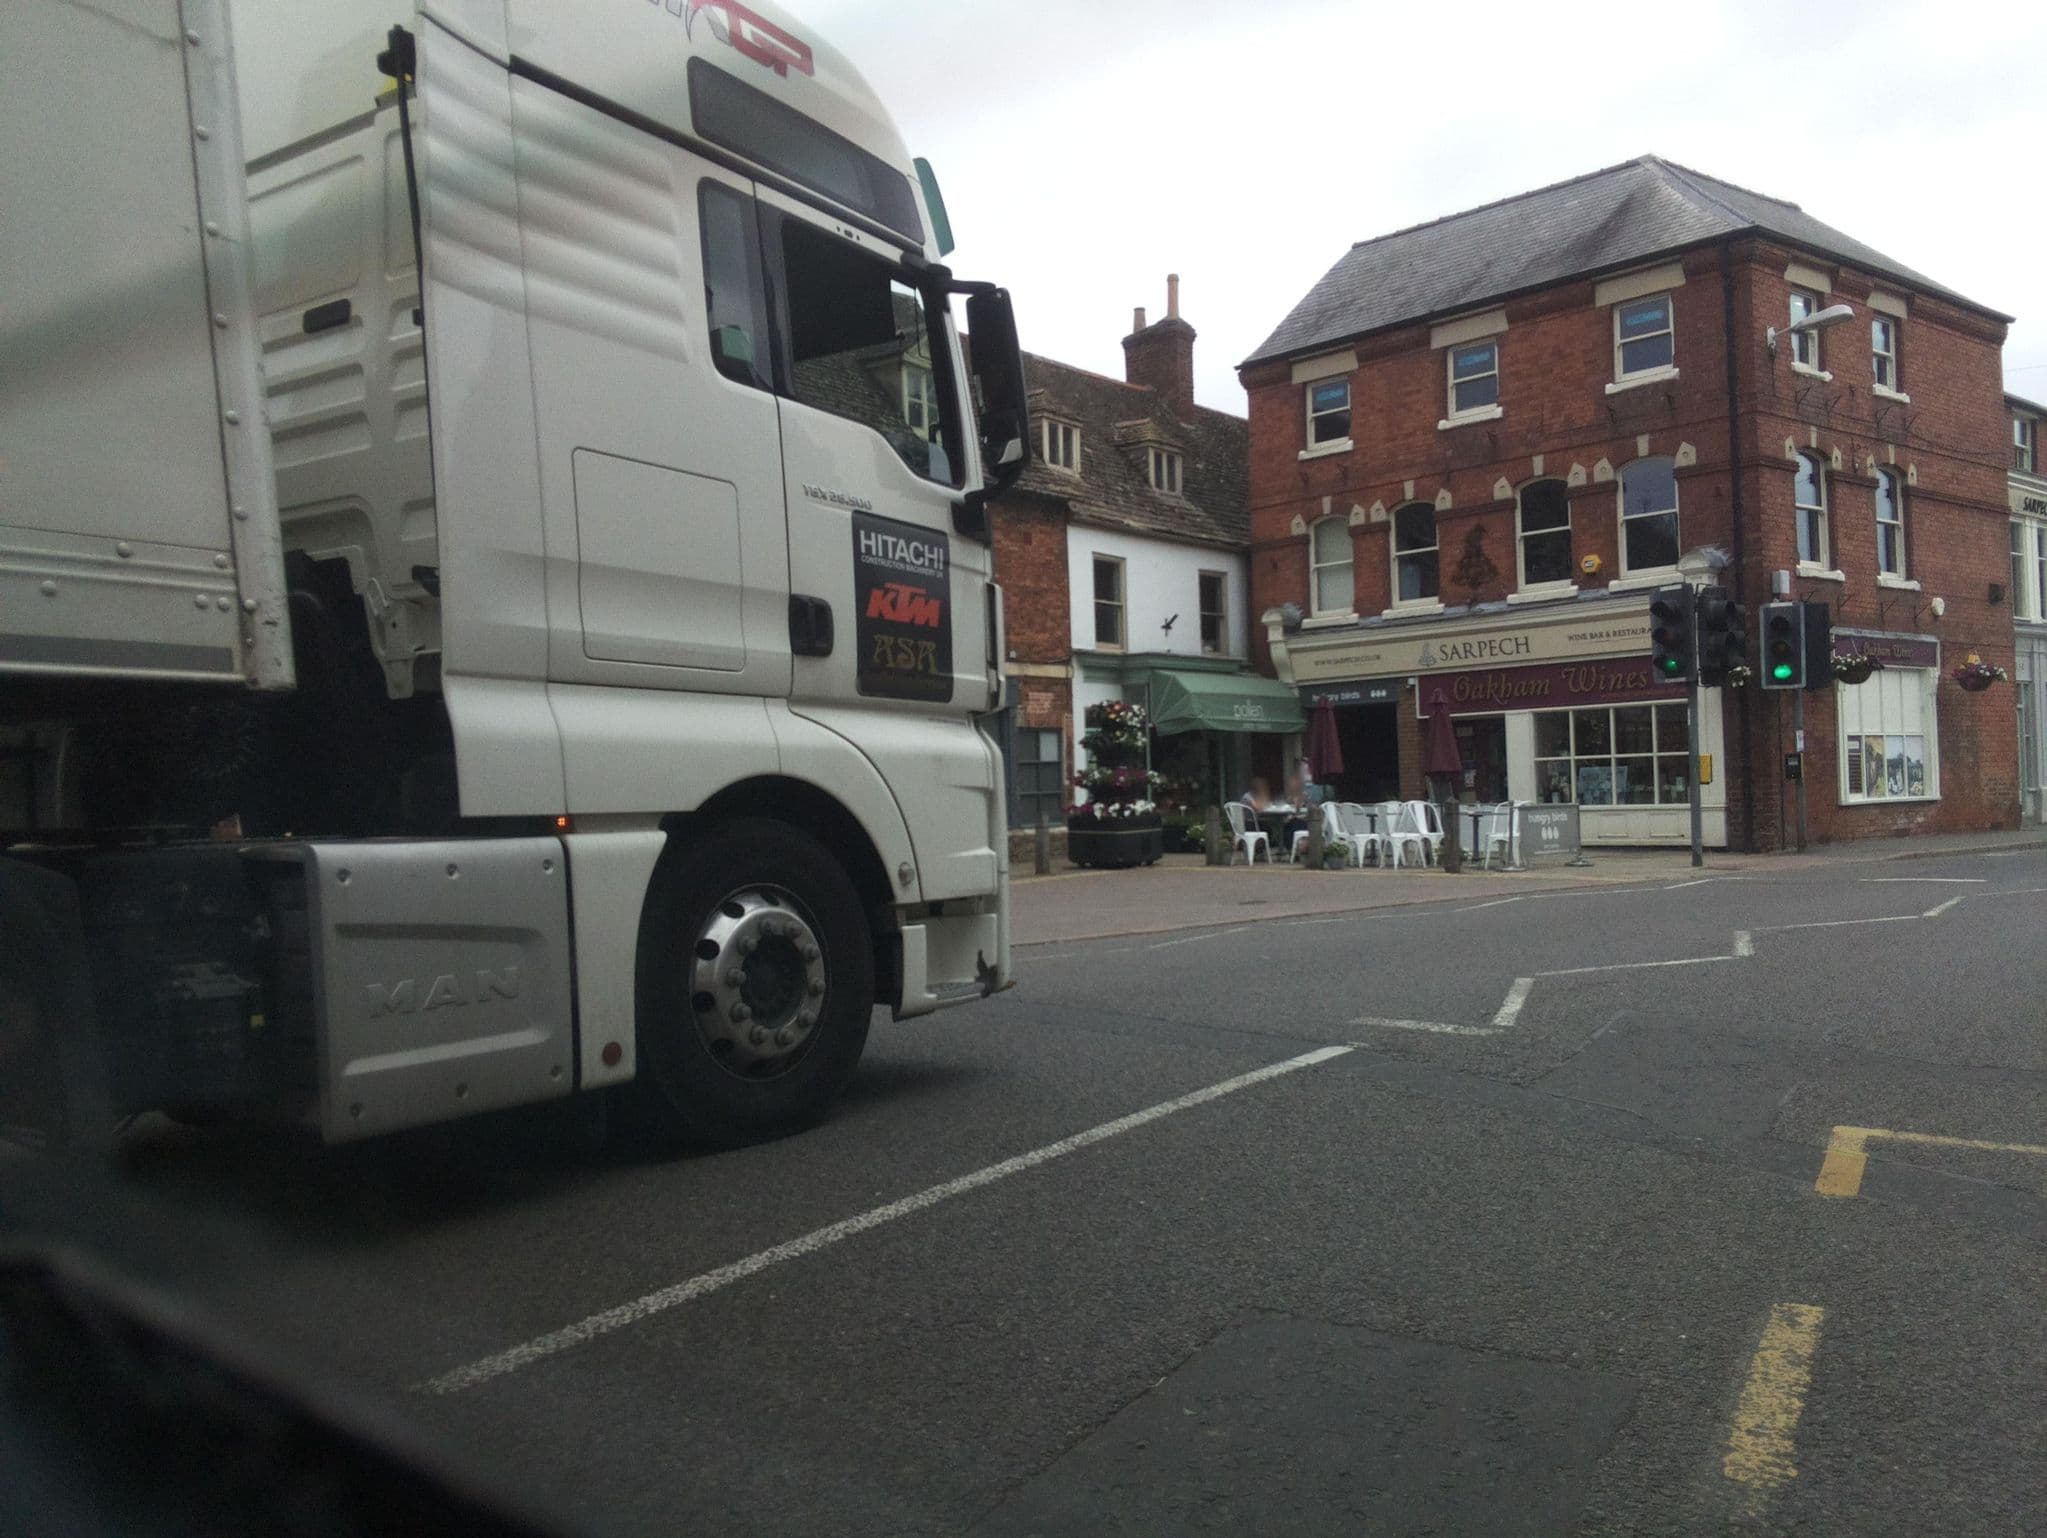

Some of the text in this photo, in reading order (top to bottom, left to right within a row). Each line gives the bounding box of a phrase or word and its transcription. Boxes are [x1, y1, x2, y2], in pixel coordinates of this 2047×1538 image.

[860, 530, 944, 570] HITACHI
[861, 555, 905, 569] CONSTRUCTION
[866, 581, 940, 628] KTM
[1439, 636, 1531, 662] SARPECH
[1567, 632, 1588, 641] WINE
[1588, 631, 1604, 640] BAR
[1452, 664, 1648, 705] Oakham Wines
[365, 966, 519, 1019] MAN
